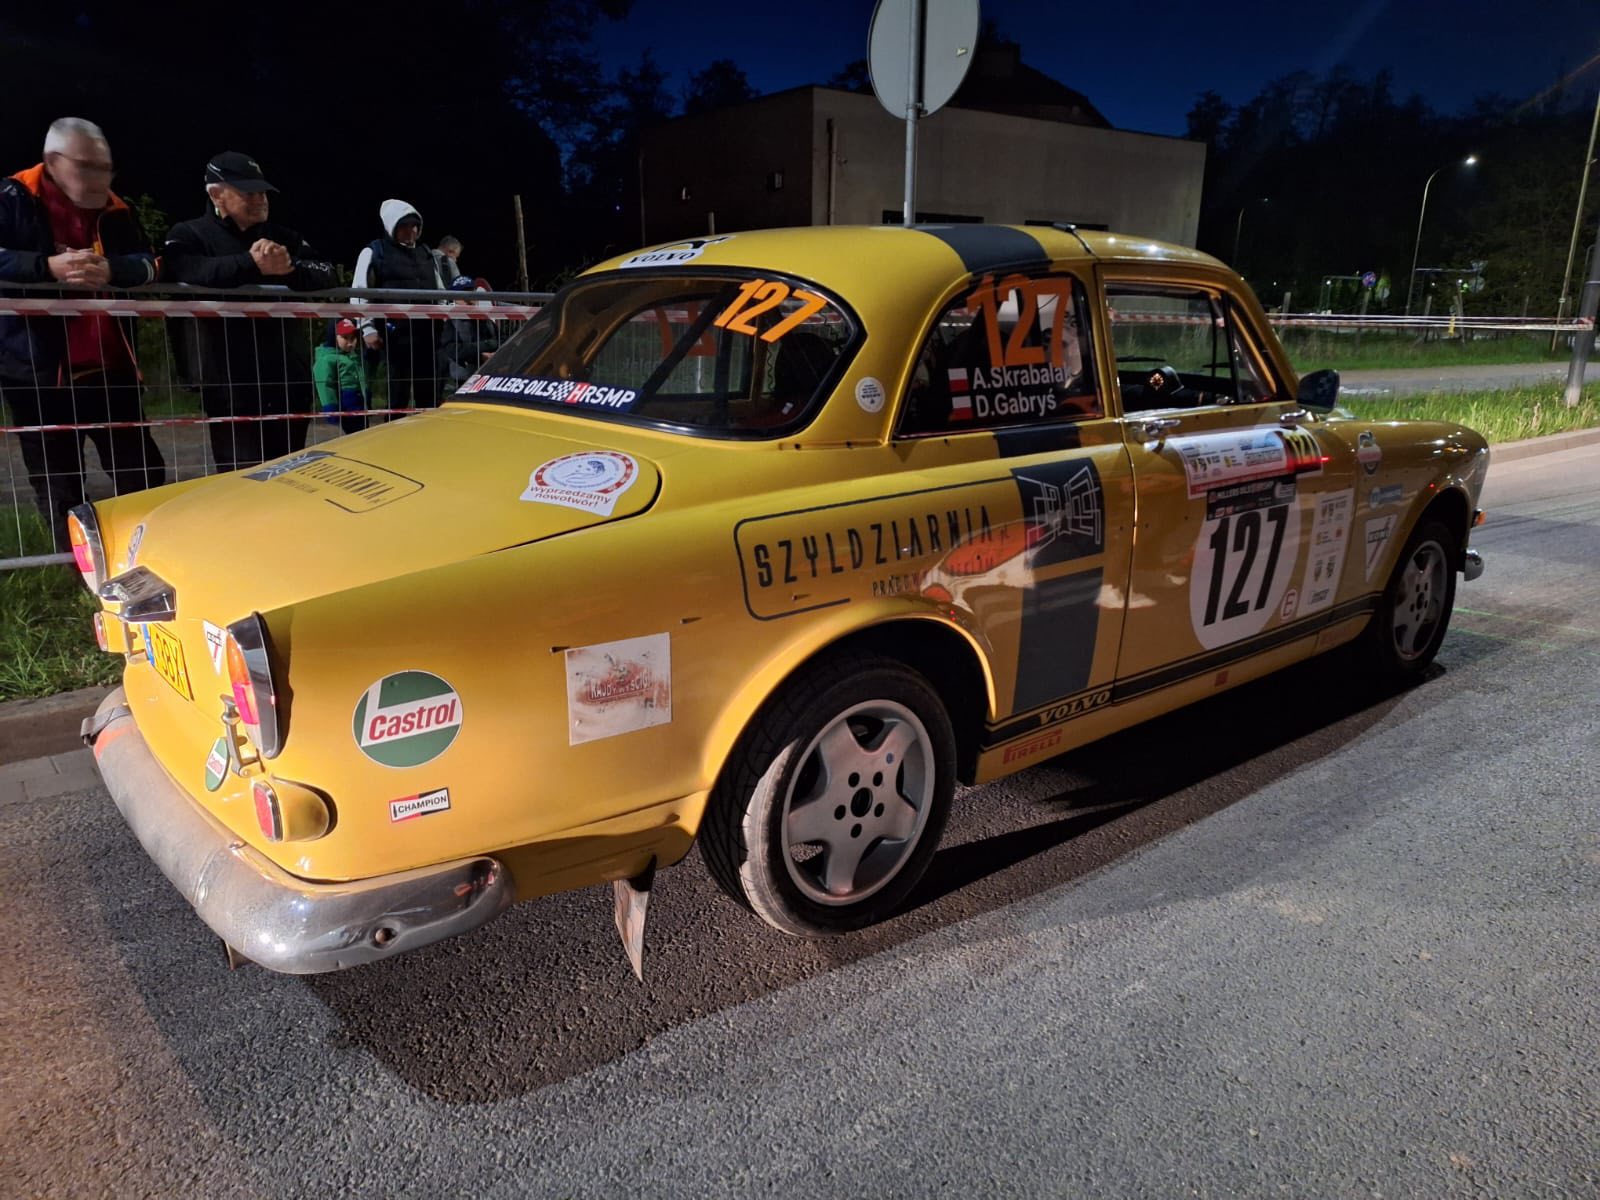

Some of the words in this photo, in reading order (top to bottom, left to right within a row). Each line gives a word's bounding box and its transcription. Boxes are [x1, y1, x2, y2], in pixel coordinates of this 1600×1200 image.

[629, 252, 696, 264] VOLVO
[713, 278, 828, 344] 127
[966, 272, 1073, 369] 127
[482, 375, 530, 394] MILLERS
[525, 379, 559, 398] OILS
[975, 388, 1057, 417] D.Gabryś
[753, 504, 993, 588] SZYLDZIARNIA
[1203, 504, 1290, 627] 127
[1282, 593, 1294, 618] E
[368, 698, 457, 741] Castrol
[1038, 691, 1111, 726] VOLVO
[1002, 729, 1064, 765] PIRELLI
[397, 795, 447, 814] CHAMPION
